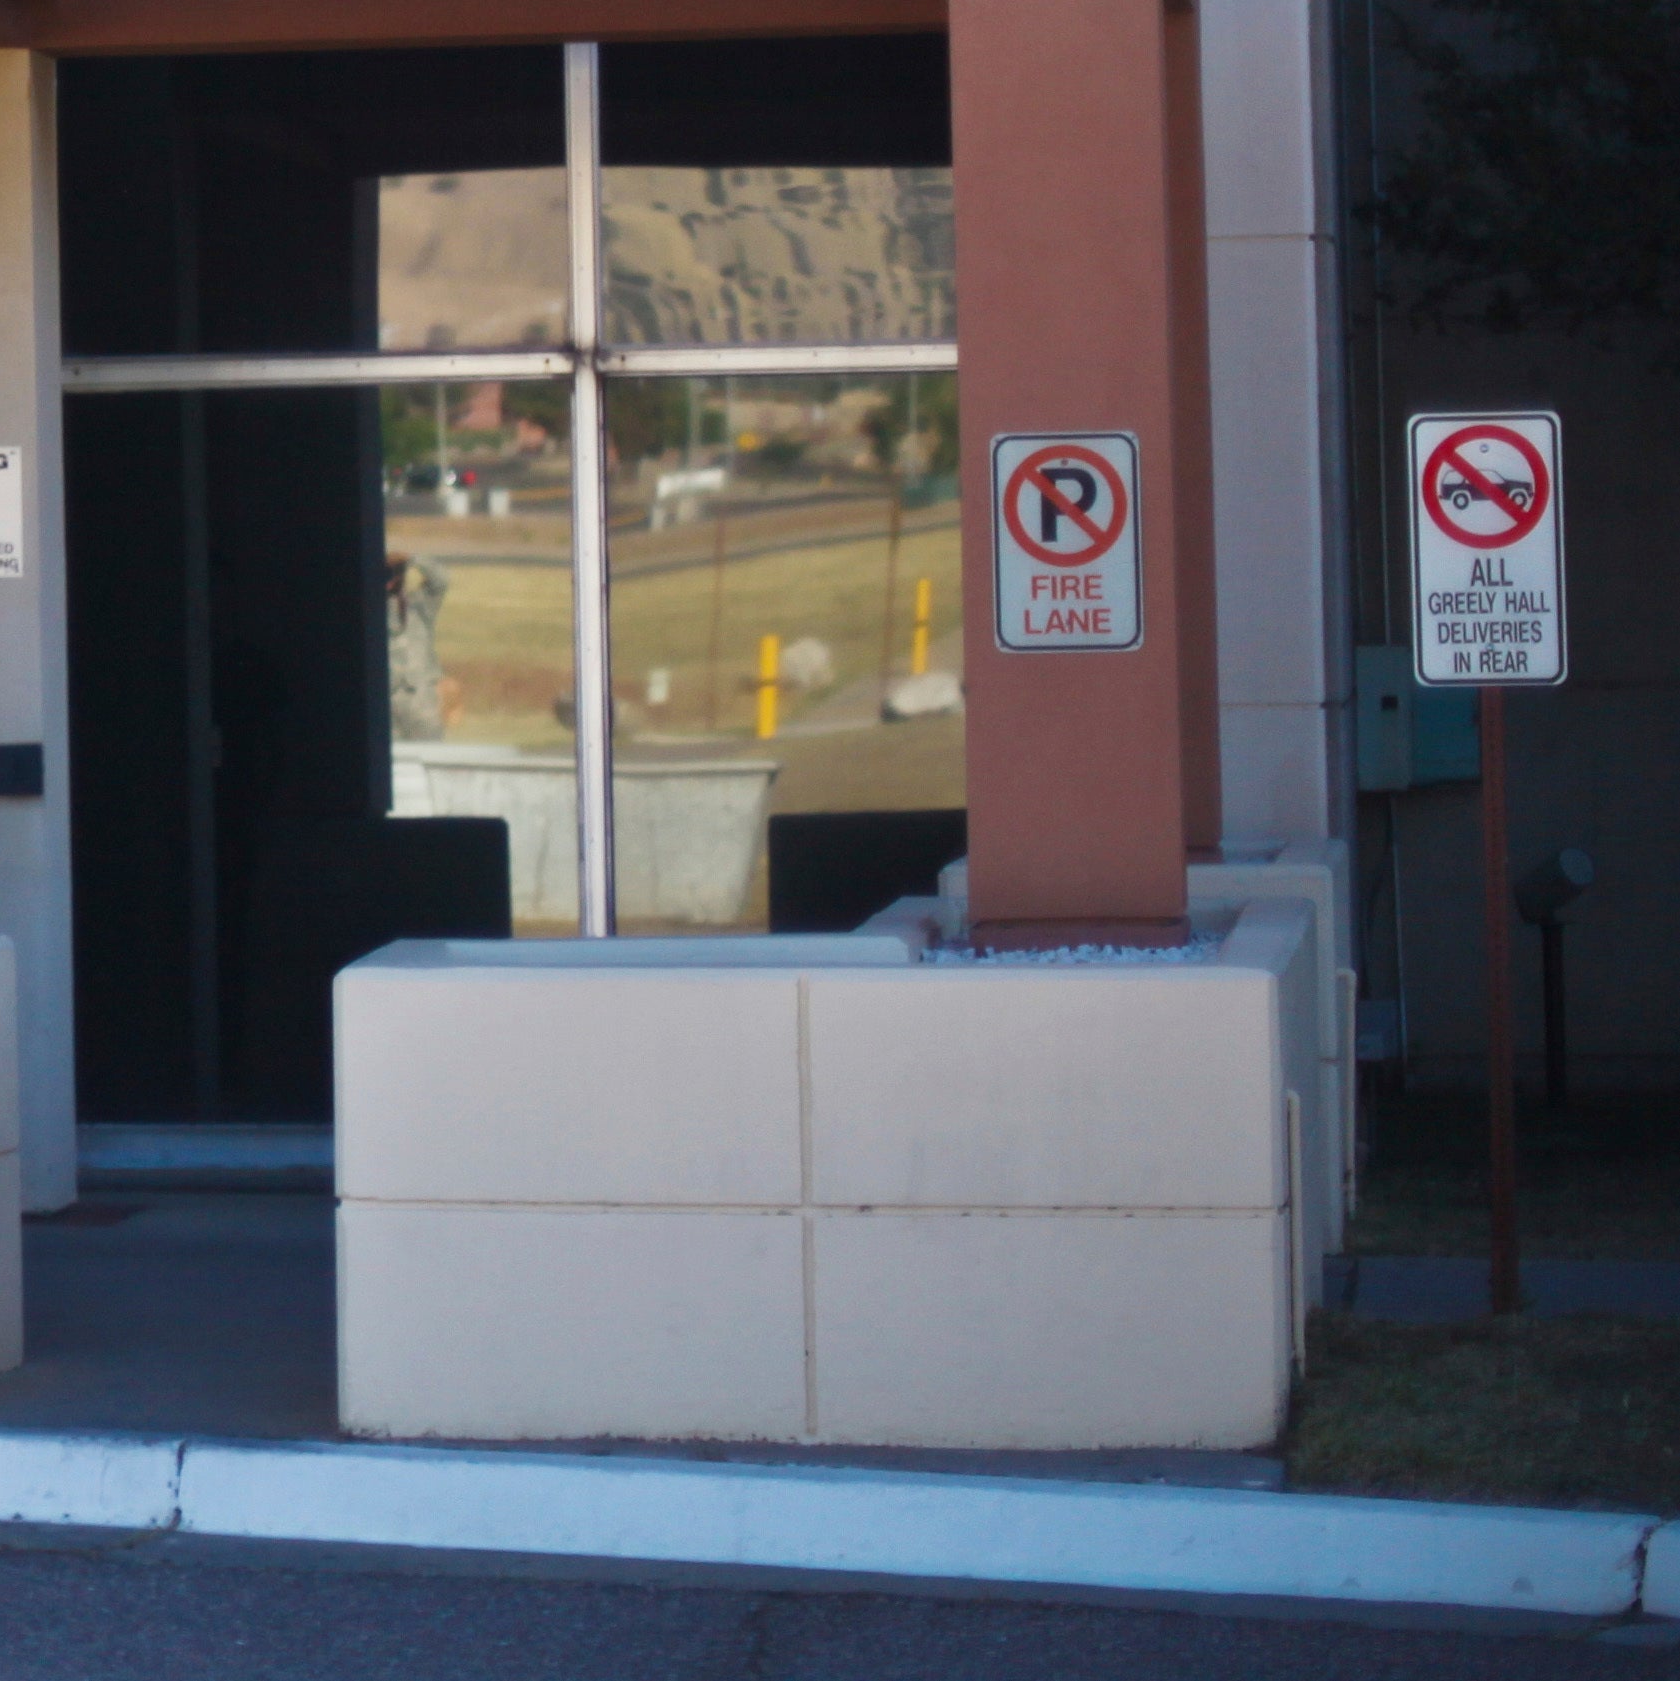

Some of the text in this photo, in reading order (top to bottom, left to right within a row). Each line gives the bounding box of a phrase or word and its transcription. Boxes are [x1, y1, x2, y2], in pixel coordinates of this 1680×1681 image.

[1470, 557, 1513, 587] ALL
[1030, 574, 1103, 601] FIRE
[1428, 590, 1550, 615] GREELY HALL
[1024, 608, 1112, 635] LANE
[1438, 620, 1543, 644] DELIVERIES
[1453, 650, 1528, 673] IN REAR
